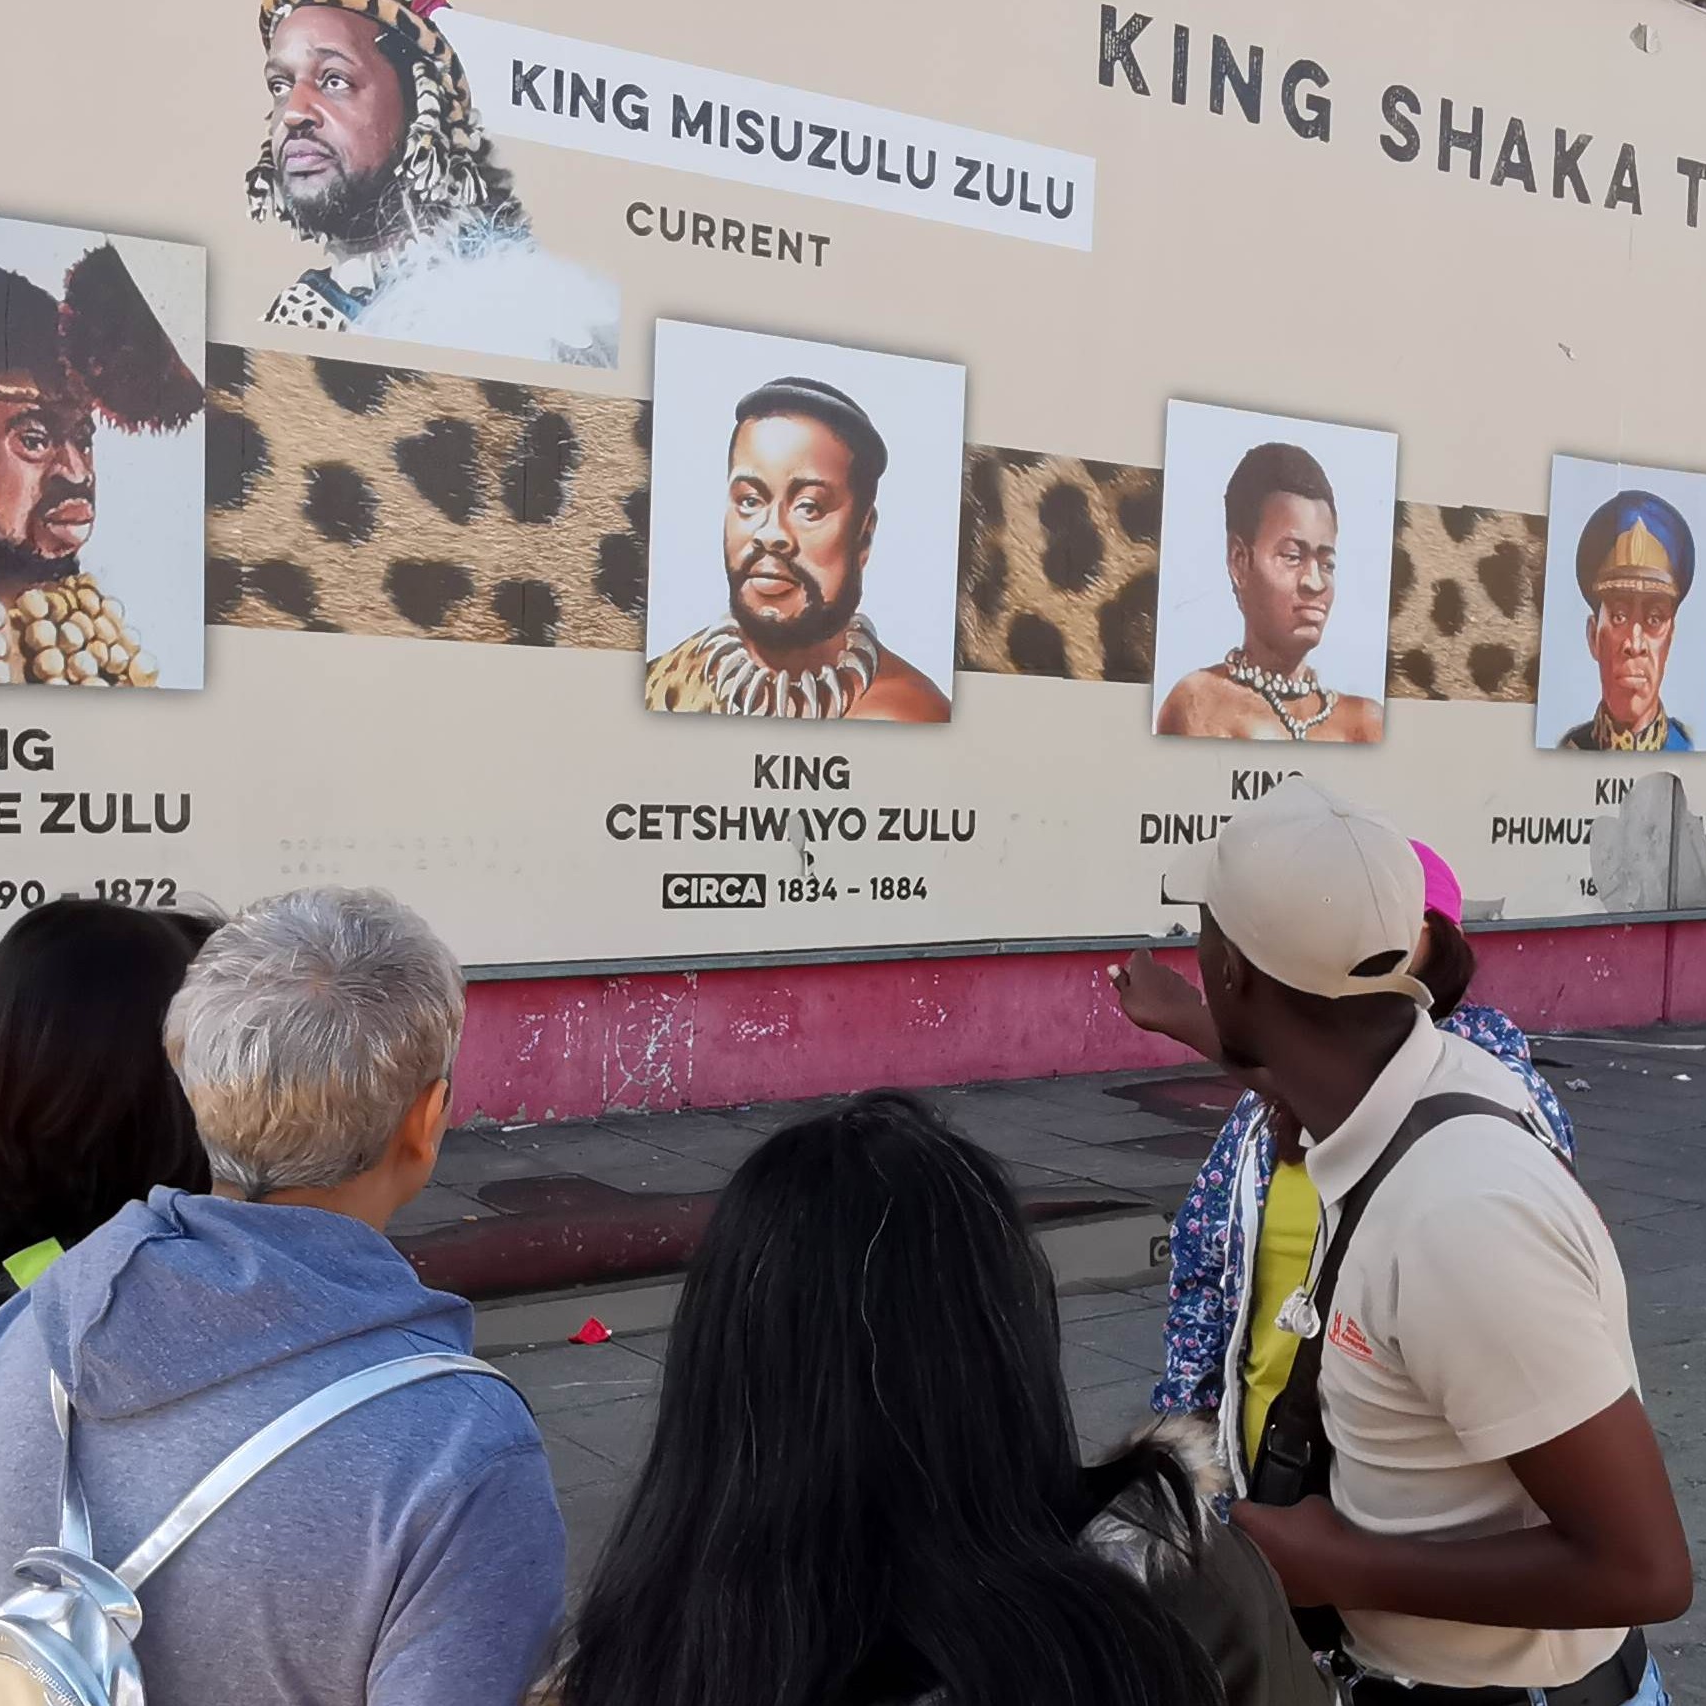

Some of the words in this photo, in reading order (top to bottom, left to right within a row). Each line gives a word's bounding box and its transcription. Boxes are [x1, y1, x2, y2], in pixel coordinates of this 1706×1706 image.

[1099, 6, 1331, 142] KING
[1380, 85, 1642, 215] SHAKA
[512, 60, 648, 132] KING
[672, 94, 936, 189] MISUZULU
[954, 156, 1073, 219] ZULU
[627, 202, 830, 266] CURRENT
[754, 755, 849, 790] KING
[1232, 770, 1302, 800] KIN
[1596, 779, 1633, 805] KIN
[40, 793, 191, 834] ZULU
[878, 808, 975, 841] ZULU
[95, 878, 177, 907] 1872
[667, 878, 762, 903] CIRCA
[778, 877, 837, 902] 1834
[870, 877, 927, 901] 1884
